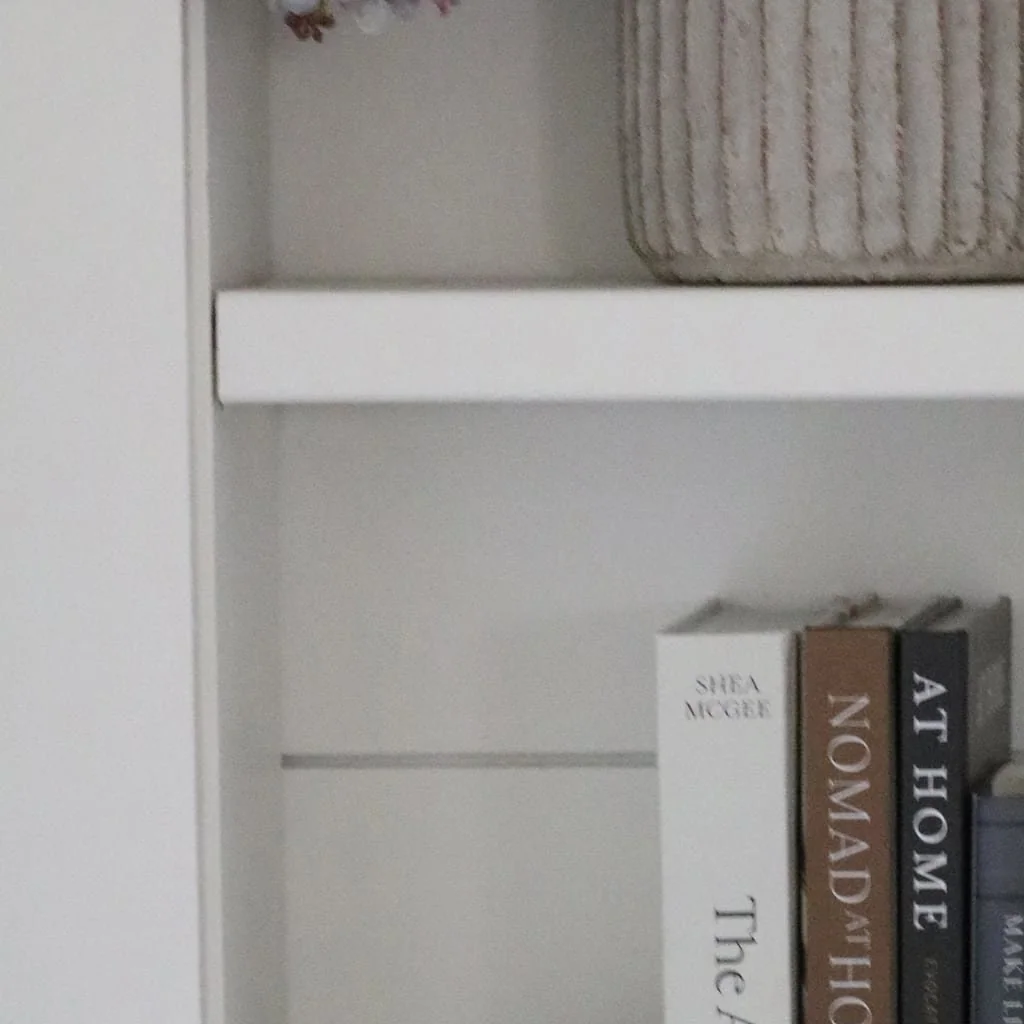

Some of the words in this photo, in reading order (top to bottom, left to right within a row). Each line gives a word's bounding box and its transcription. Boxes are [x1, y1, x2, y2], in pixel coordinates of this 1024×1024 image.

[685, 699, 771, 720] MCGEE
[695, 672, 760, 694] SHEA
[912, 671, 948, 744] AT
[827, 692, 872, 905] NOMAD
[912, 764, 948, 931] HOME
[713, 895, 757, 995] The
[845, 908, 872, 950] AT
[1002, 914, 1024, 992] MAKE
